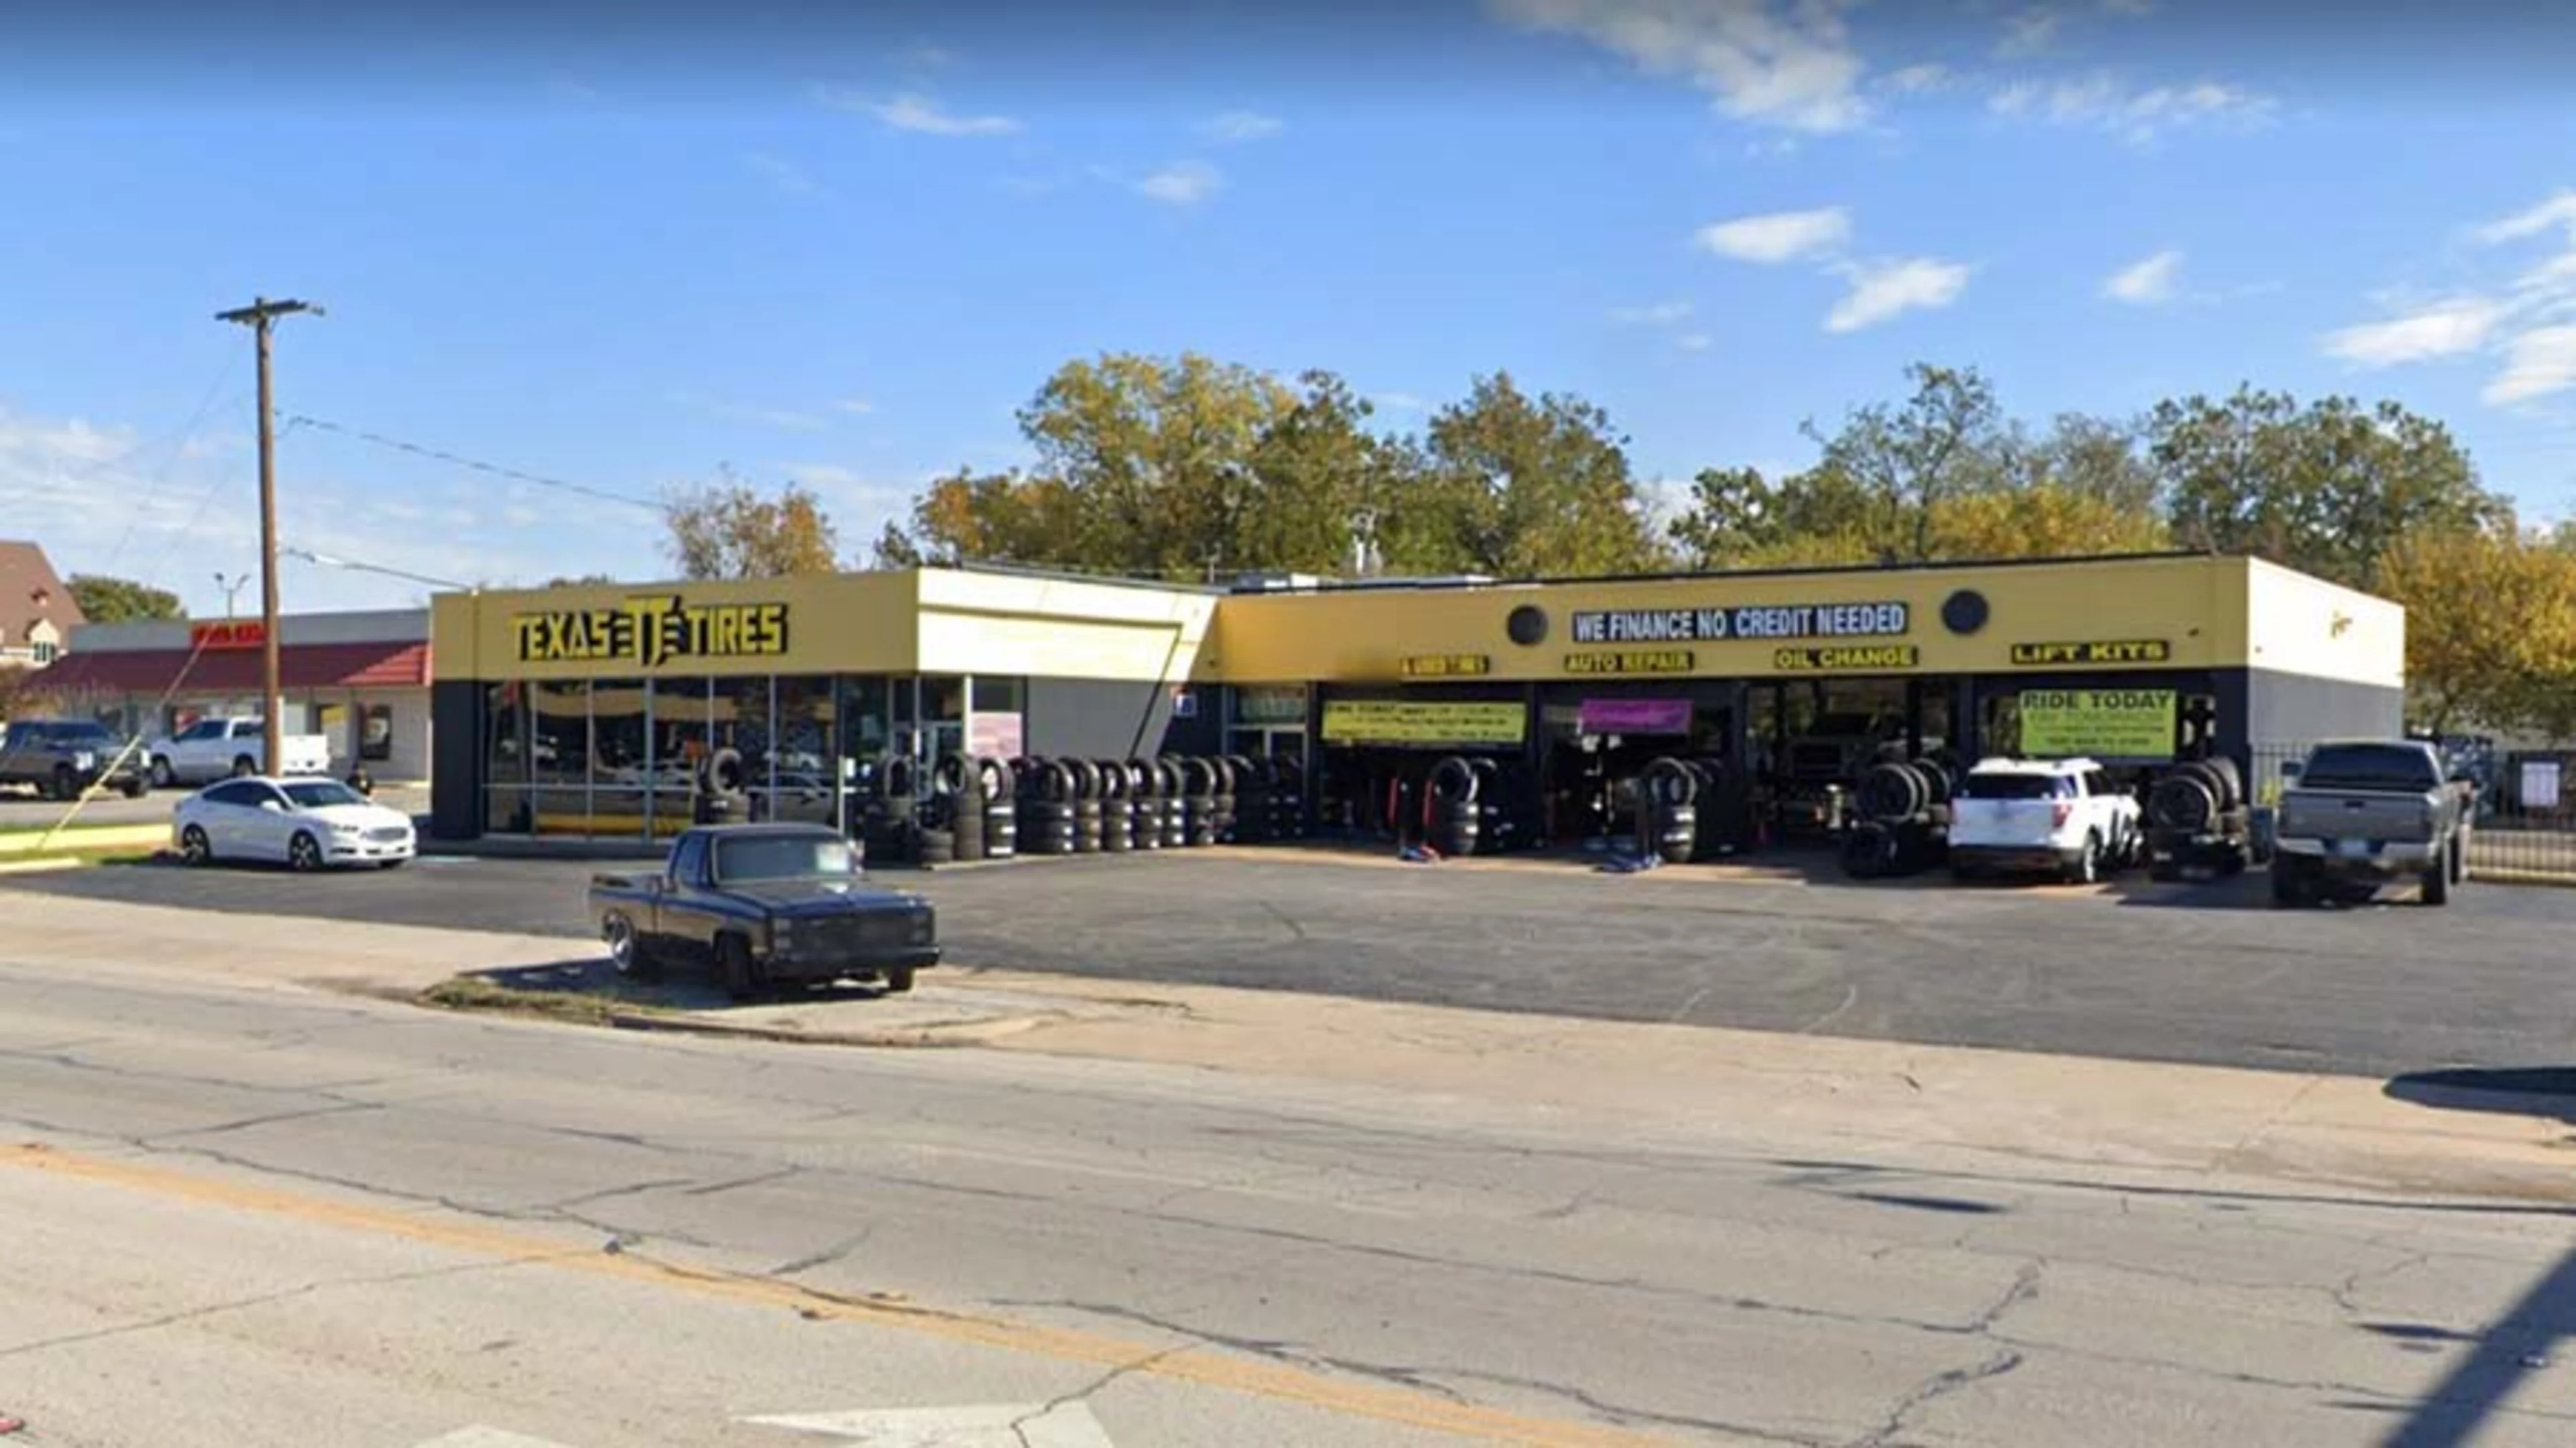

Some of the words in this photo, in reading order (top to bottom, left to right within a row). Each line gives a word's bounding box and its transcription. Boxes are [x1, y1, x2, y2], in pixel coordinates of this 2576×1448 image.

[510, 611, 613, 661] TEXAS
[686, 604, 786, 655] TIRES
[1576, 613, 1604, 641] WE
[1611, 610, 1693, 641] FINANCE
[1697, 609, 1727, 637] NO
[1736, 608, 1811, 636] CREDIT
[1817, 604, 1905, 635] NEEDED
[1567, 655, 1617, 671] AUTO
[1621, 652, 1689, 671] REPAIR
[1778, 651, 1811, 668] OIL
[1819, 645, 1912, 666] CHANGE
[2015, 645, 2078, 663] LIFT
[2090, 642, 2165, 661] KITS
[2023, 691, 2078, 710] RIDE
[2088, 691, 2171, 710] TODAY
